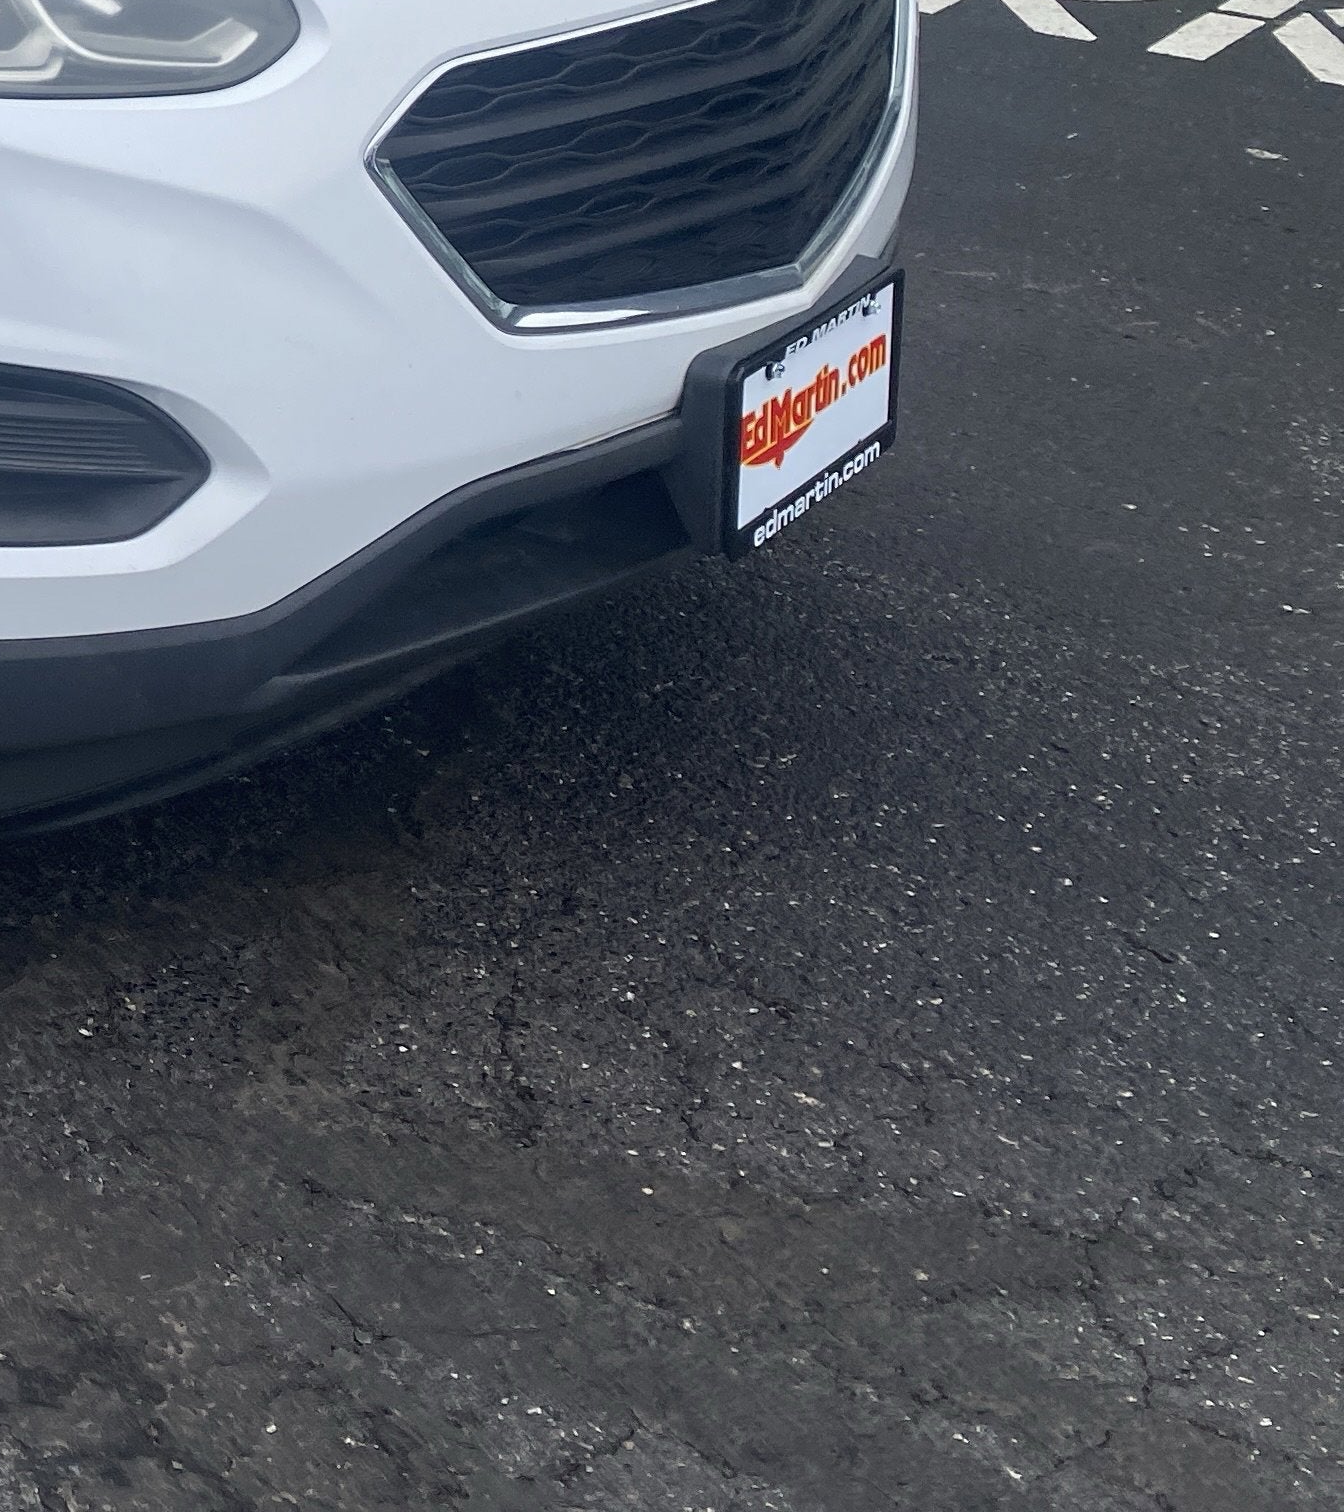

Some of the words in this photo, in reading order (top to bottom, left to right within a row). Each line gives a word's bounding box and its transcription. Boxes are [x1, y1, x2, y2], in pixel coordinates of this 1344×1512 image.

[784, 336, 809, 360] ED
[811, 293, 872, 344] MARTIN
[740, 333, 886, 452] EdMartin.com
[753, 439, 881, 548] edmartin.com
